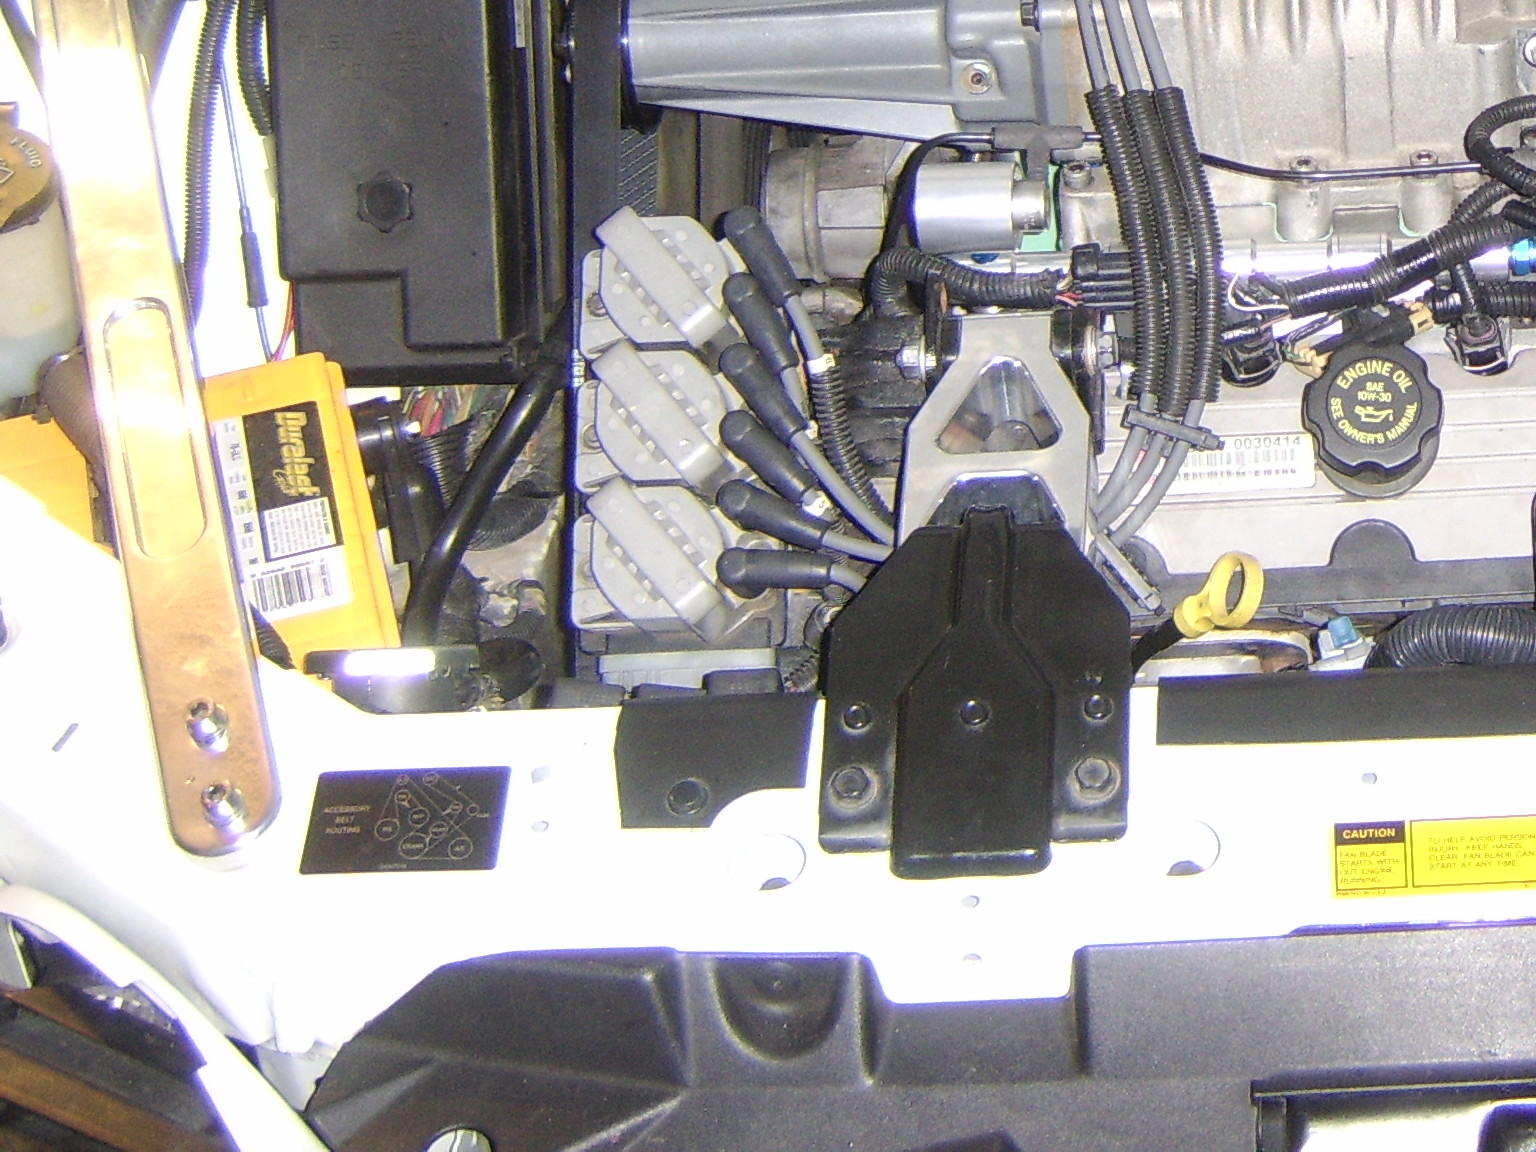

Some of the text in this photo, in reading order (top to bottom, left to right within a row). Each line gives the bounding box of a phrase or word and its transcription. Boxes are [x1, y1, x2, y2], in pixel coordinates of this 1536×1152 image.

[1336, 359, 1413, 394] ENGINE OIL
[1366, 381, 1385, 392] SAE
[1330, 397, 1344, 421] SEE
[1385, 401, 1418, 441] MANUAL
[273, 411, 321, 497] Duralast
[1342, 827, 1397, 840] CAUTION
[1443, 836, 1466, 844] HELP
